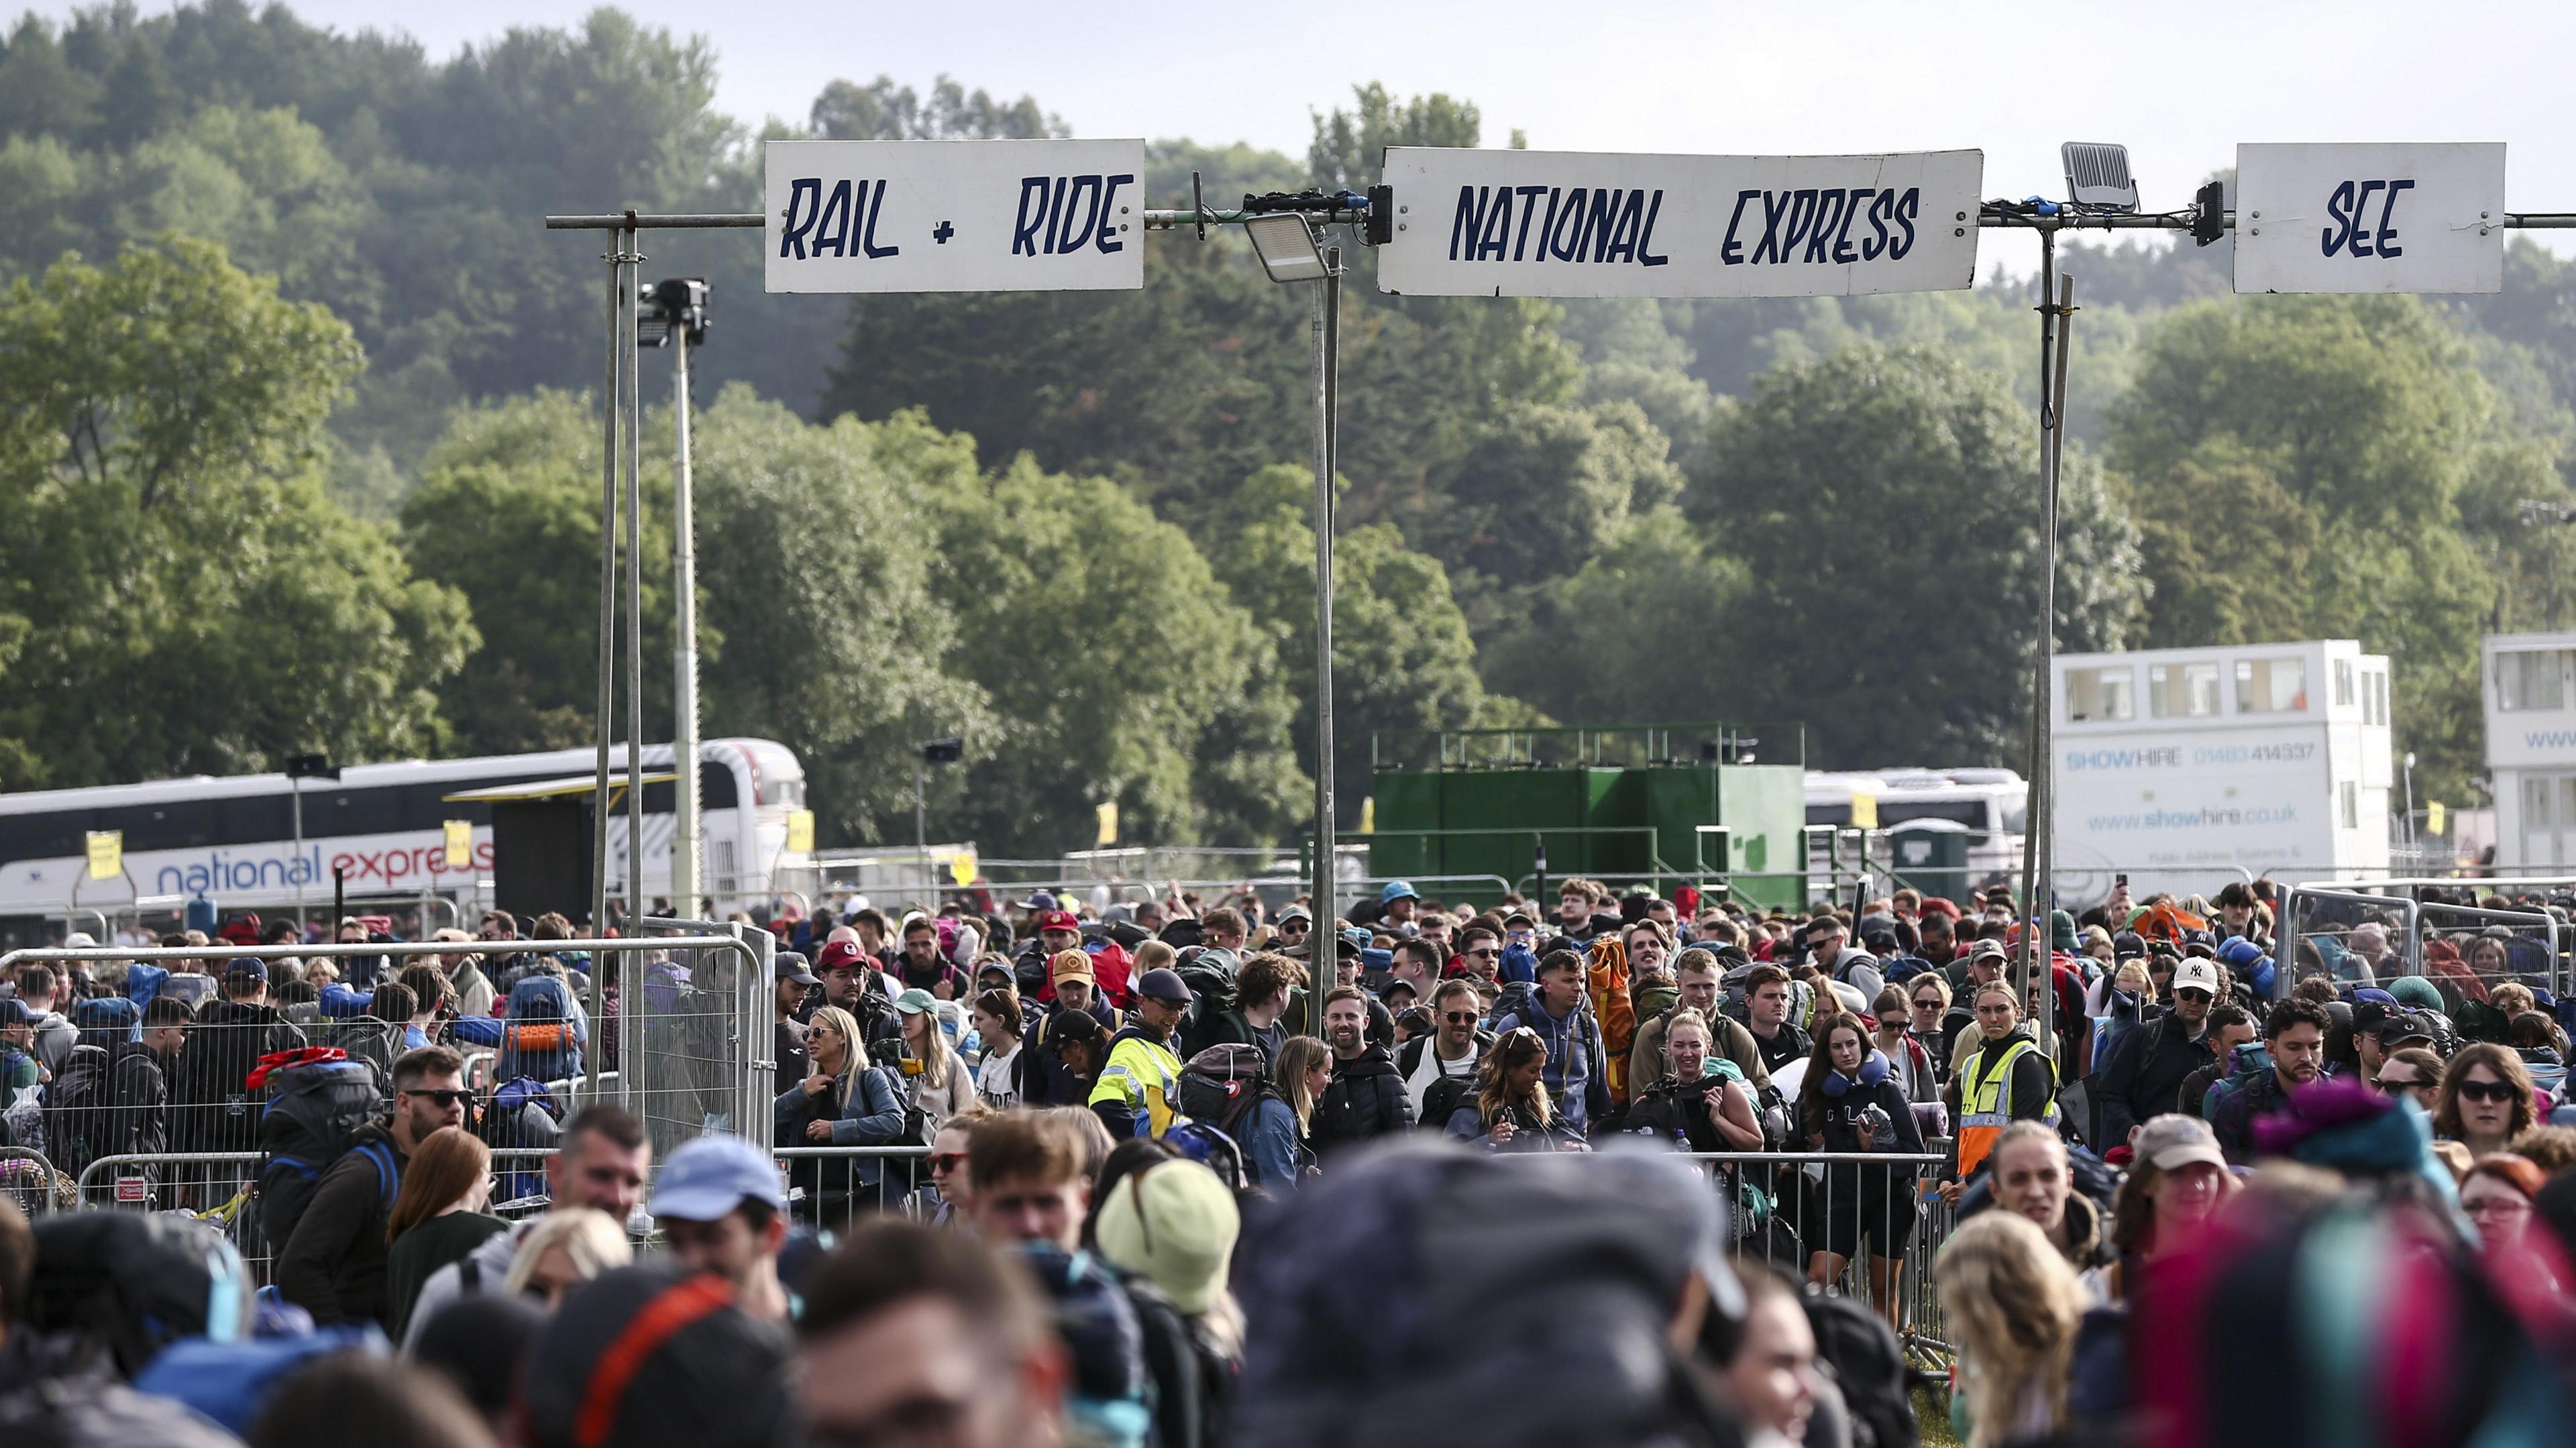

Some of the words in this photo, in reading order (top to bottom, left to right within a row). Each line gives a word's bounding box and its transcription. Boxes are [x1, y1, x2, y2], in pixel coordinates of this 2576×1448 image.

[780, 178, 899, 260] RAIL
[932, 220, 955, 245] +
[1012, 174, 1134, 258] RIDE
[1449, 185, 1668, 267] NATIONAL
[1721, 187, 1919, 266] EXPRESS
[2321, 179, 2415, 260] SEE
[2065, 745, 2182, 772] SHOWHIRE
[2088, 805, 2298, 831] www.showhire.co.uk
[157, 844, 322, 894] national
